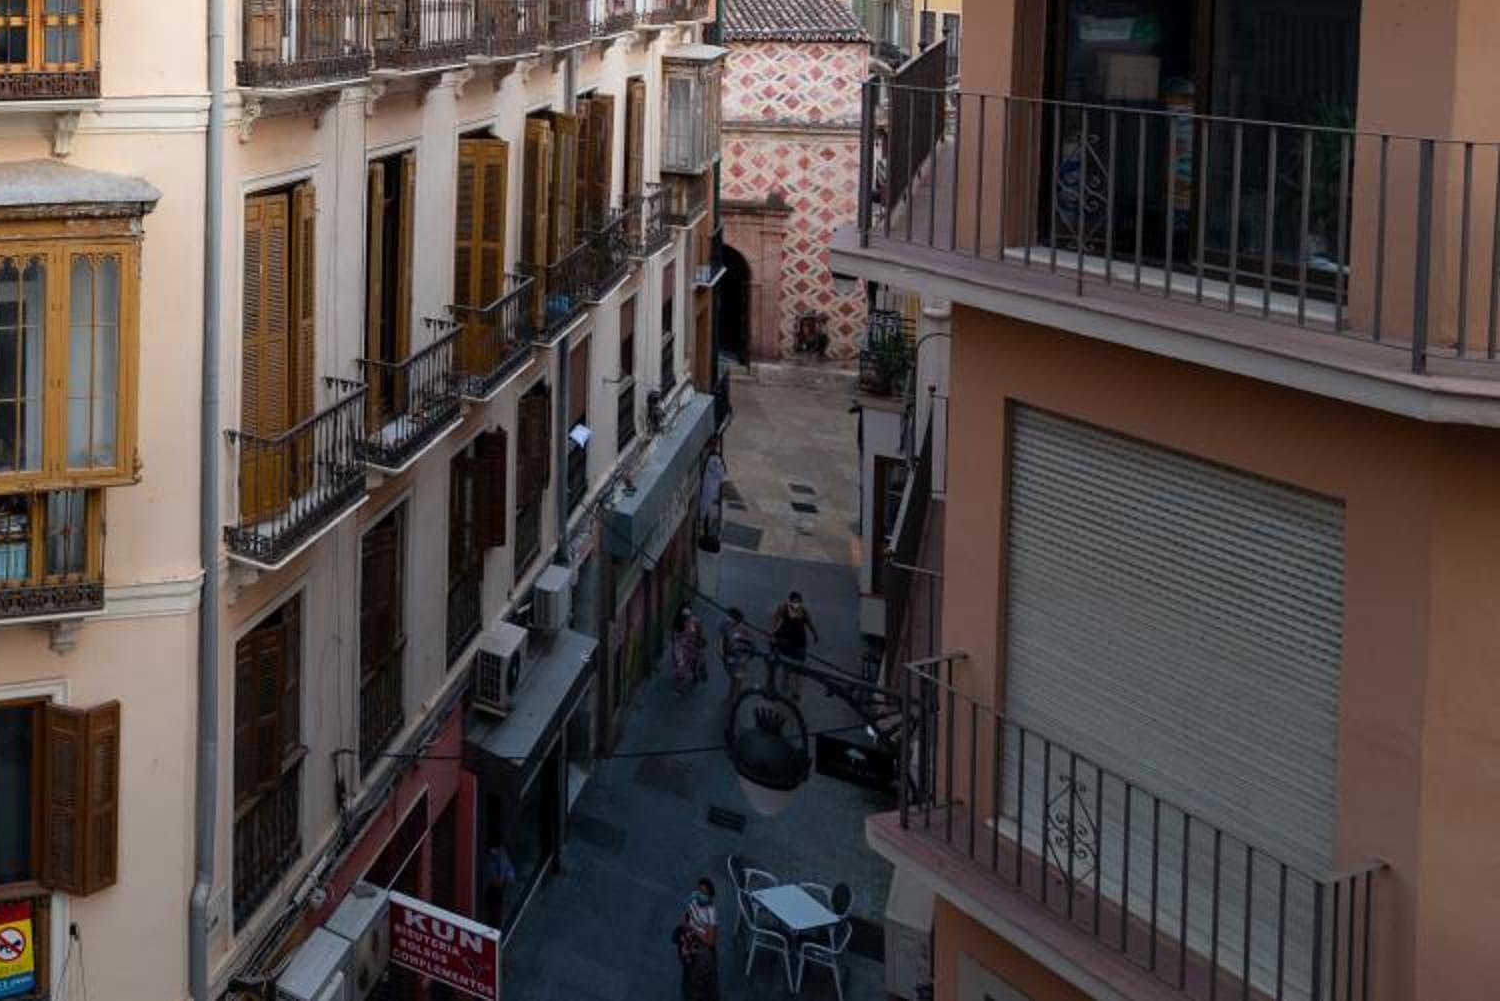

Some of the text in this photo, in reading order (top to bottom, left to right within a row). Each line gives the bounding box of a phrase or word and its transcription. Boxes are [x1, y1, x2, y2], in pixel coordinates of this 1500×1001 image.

[399, 937, 449, 964] BOLSOS
[403, 908, 484, 954] KUN
[391, 948, 494, 996] COMPLEMENTOS
